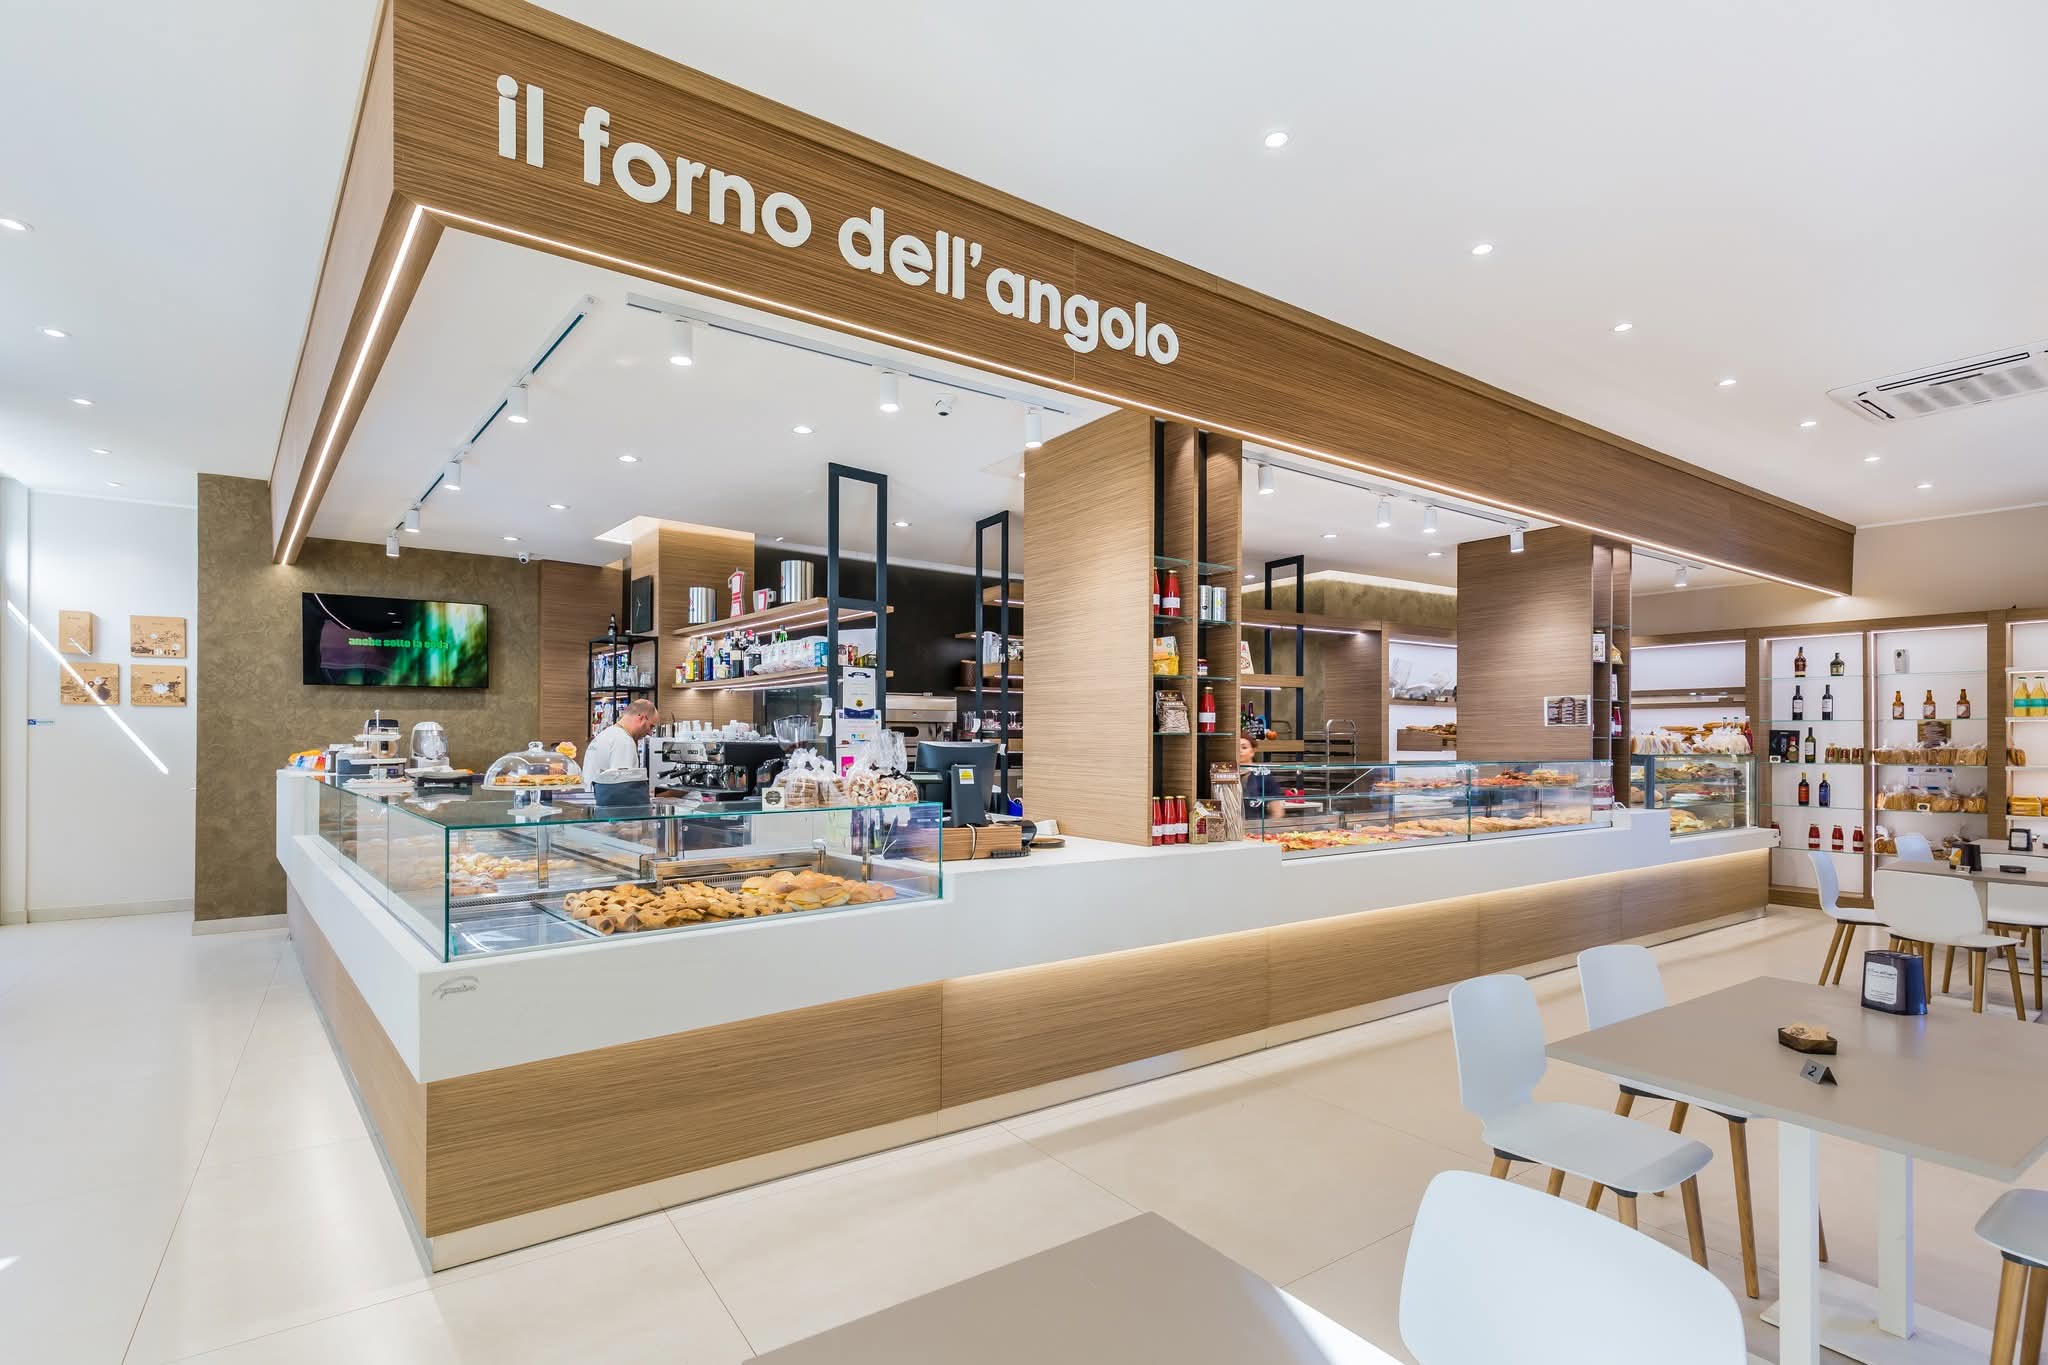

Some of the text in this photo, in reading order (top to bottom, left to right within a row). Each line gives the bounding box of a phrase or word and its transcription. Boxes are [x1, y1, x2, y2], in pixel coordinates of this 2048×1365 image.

[496, 74, 544, 168] il
[578, 106, 812, 248] forno
[1807, 1065, 1817, 1077] 2
